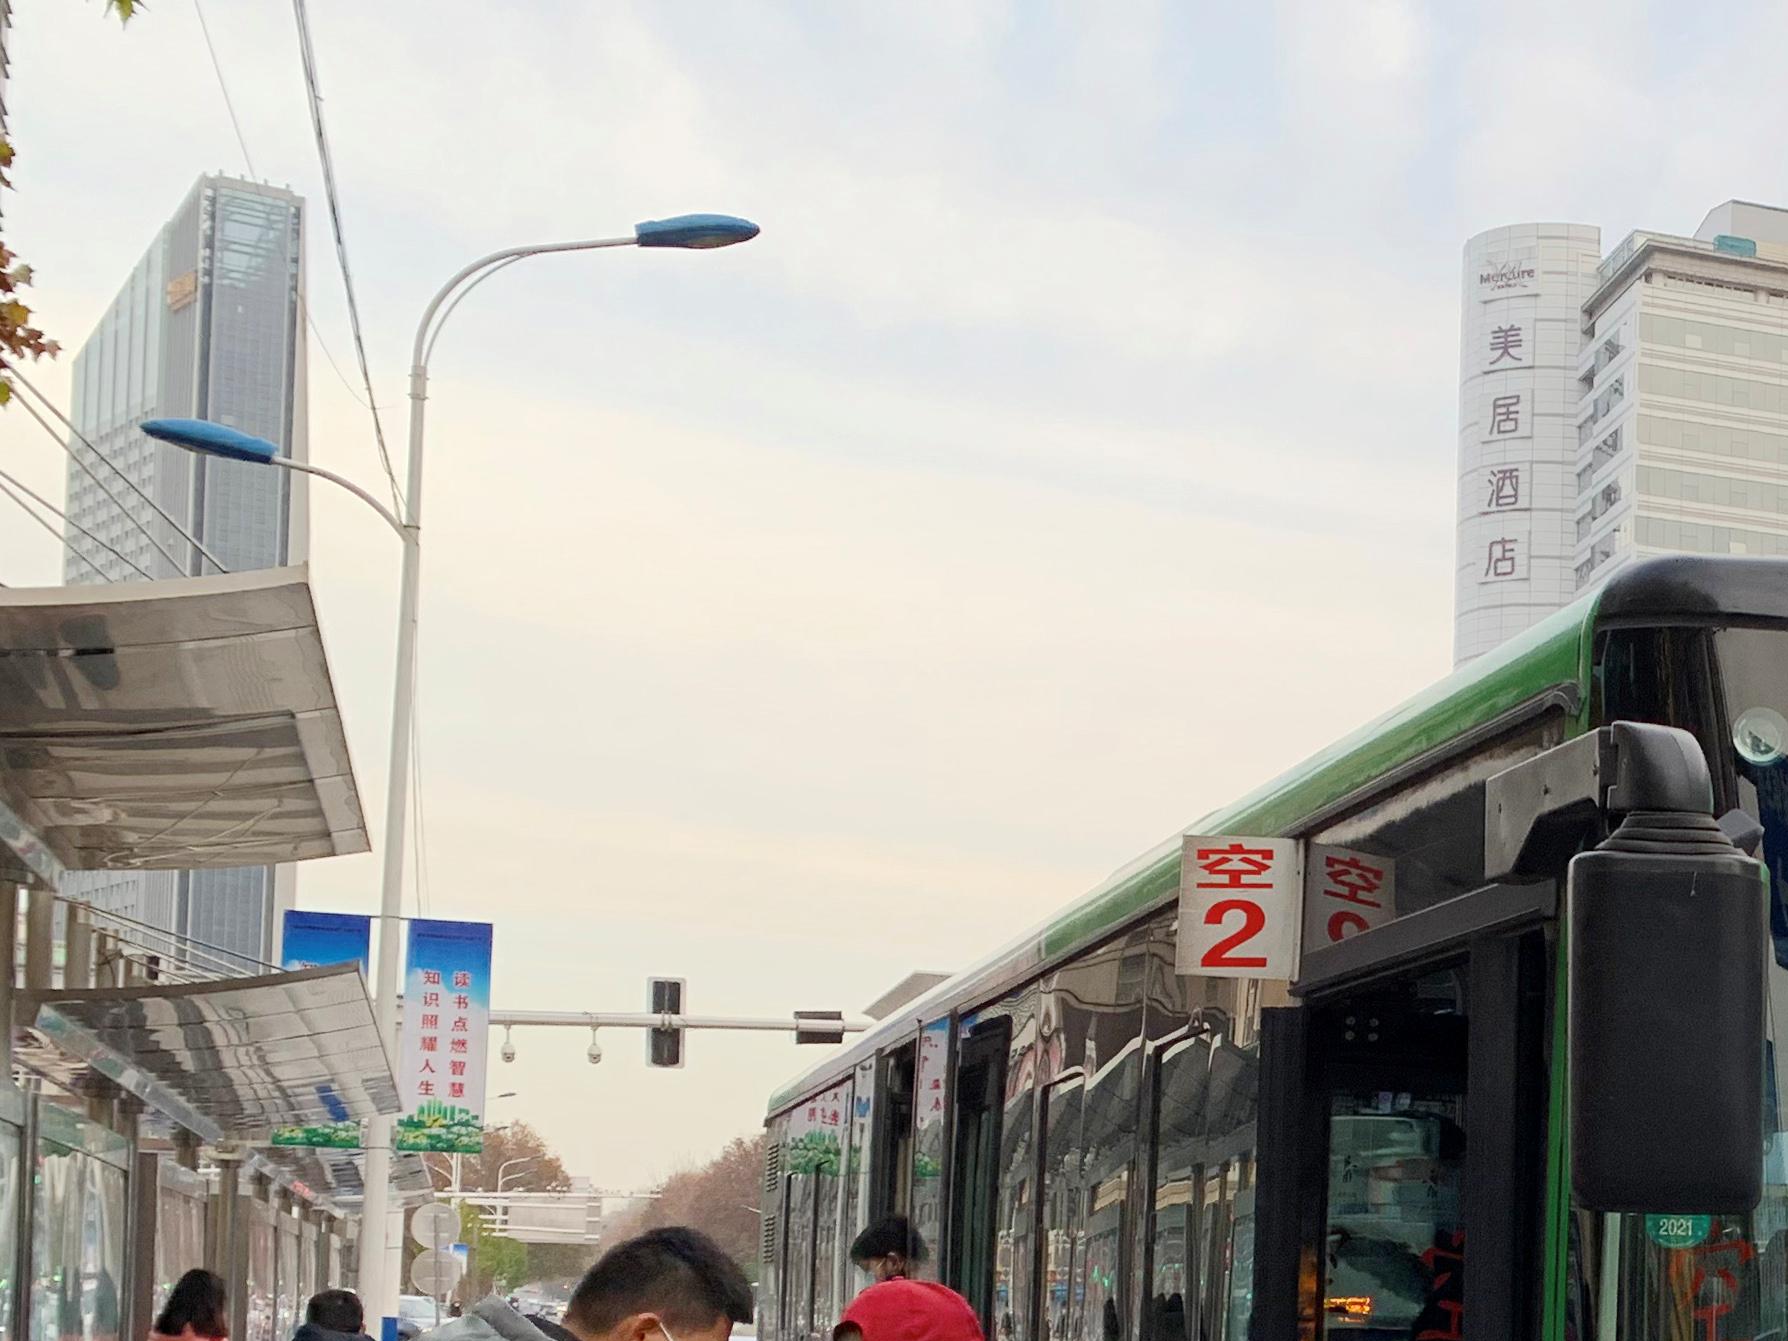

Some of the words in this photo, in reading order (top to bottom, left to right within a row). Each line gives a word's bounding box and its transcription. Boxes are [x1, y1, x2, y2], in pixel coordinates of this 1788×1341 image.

[1484, 323, 1524, 578] 美居酒店
[1196, 842, 1274, 889] 空
[1200, 898, 1268, 969] 2
[418, 970, 441, 1097] 知识照耀人生
[447, 971, 471, 1098] 读书点燃智慧
[1658, 1218, 1694, 1236] 2021
